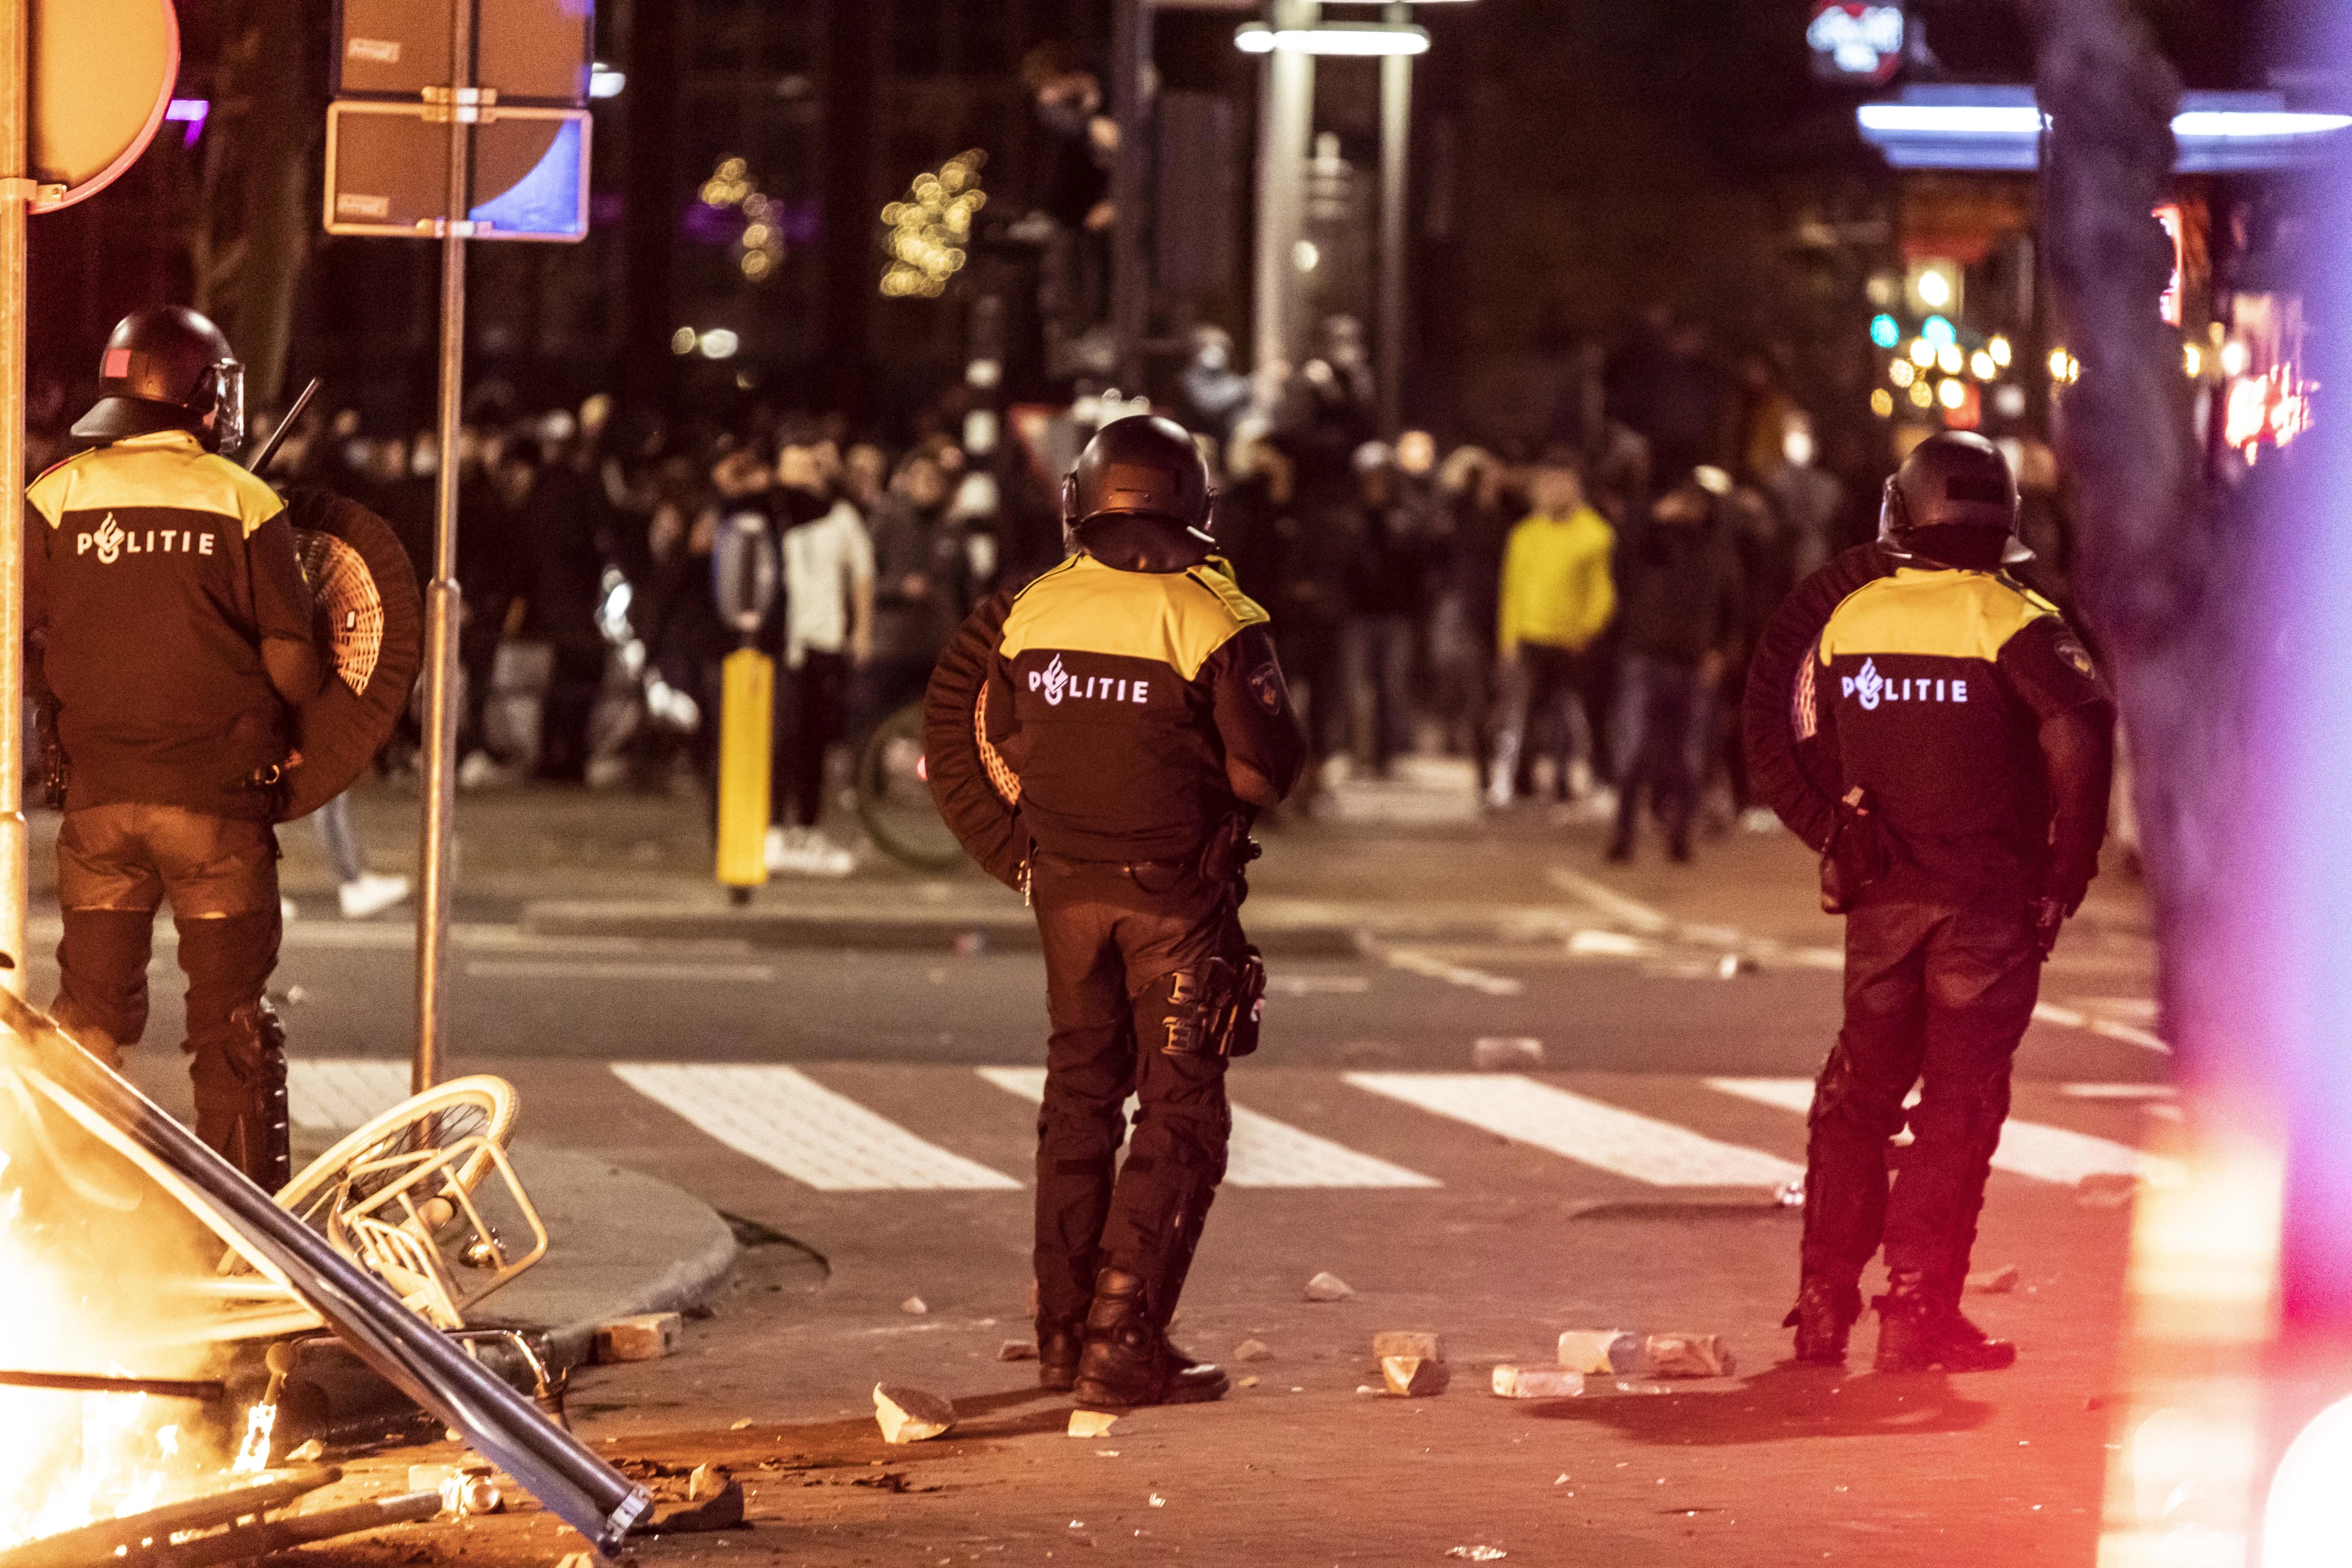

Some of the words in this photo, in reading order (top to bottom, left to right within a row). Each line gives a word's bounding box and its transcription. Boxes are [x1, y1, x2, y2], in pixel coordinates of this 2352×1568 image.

[77, 524, 214, 564] POLITIE
[1028, 664, 1148, 705] POLITIE
[1841, 669, 1967, 710] POLITIE
